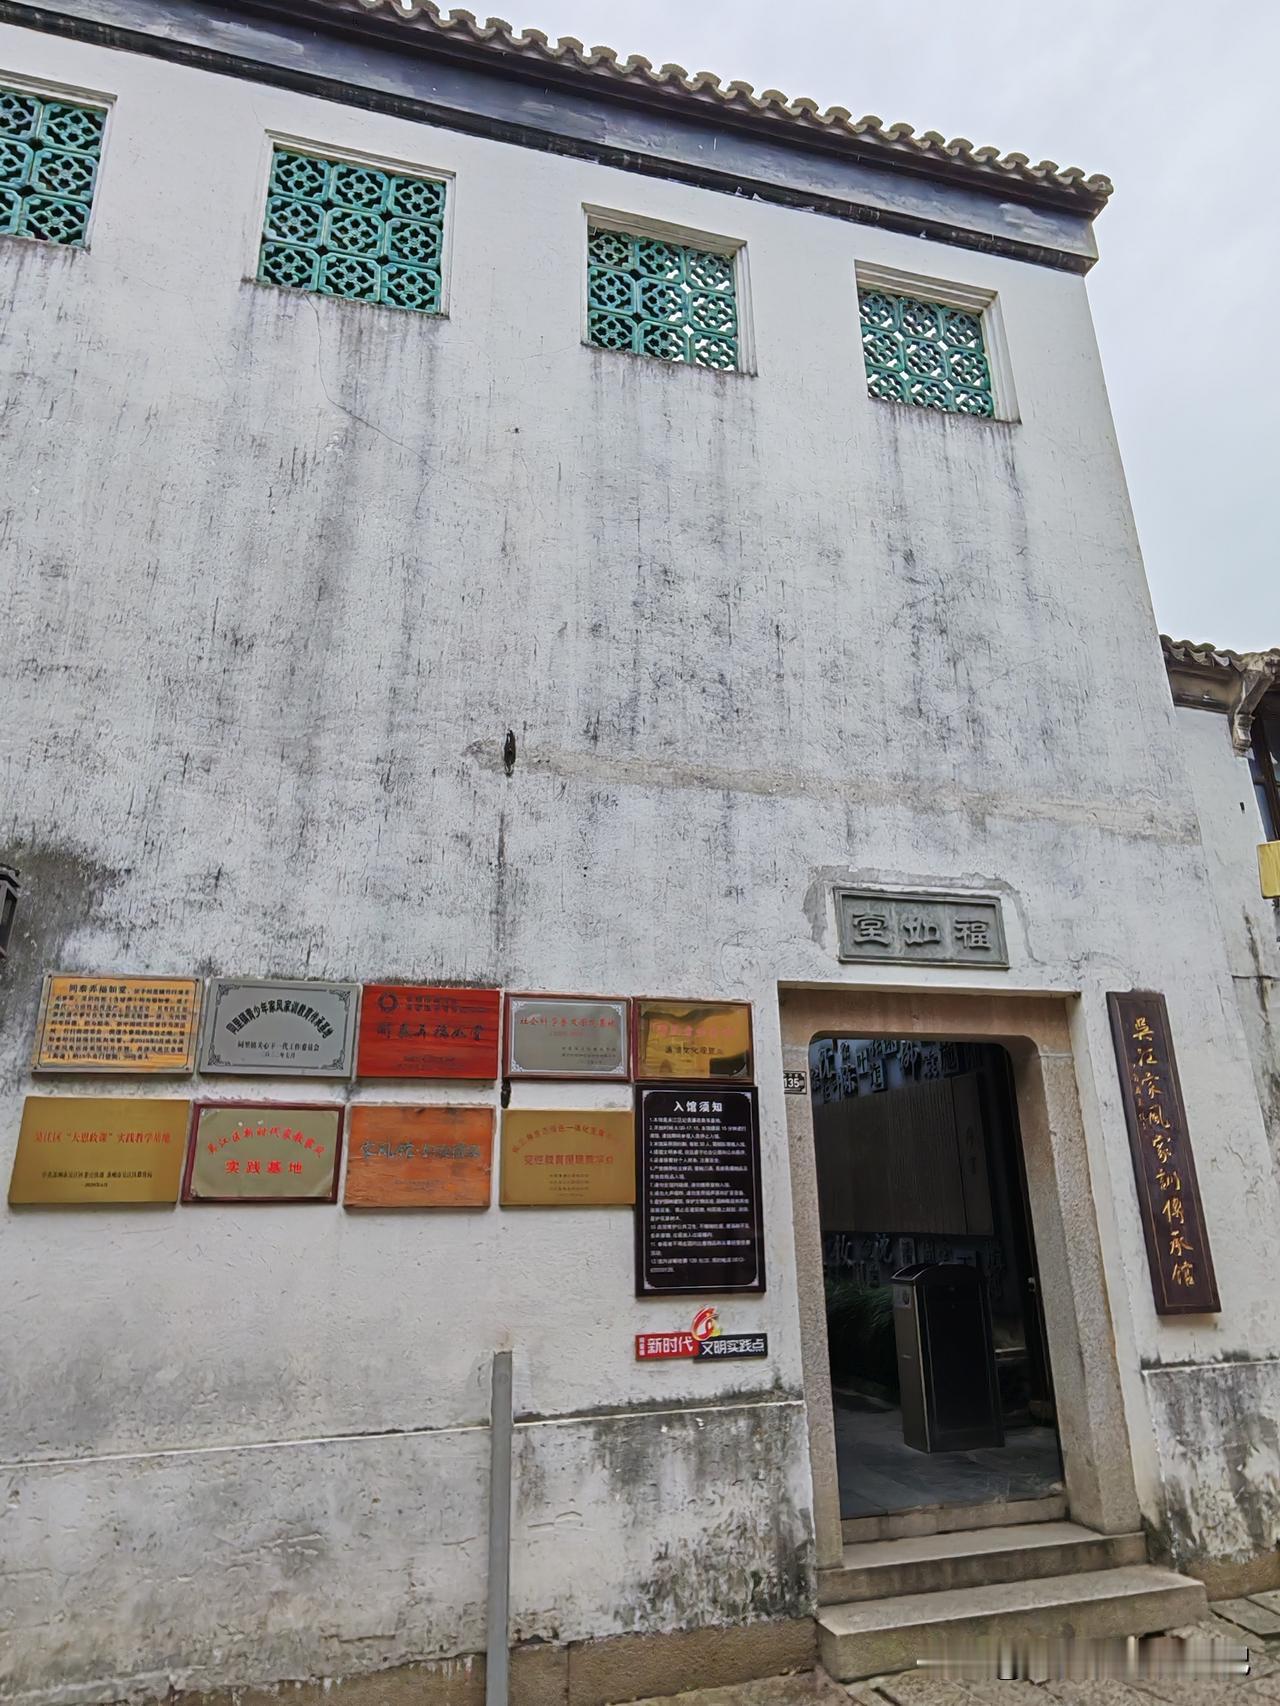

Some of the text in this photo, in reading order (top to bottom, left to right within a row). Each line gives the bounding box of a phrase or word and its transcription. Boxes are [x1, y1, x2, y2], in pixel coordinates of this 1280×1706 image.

[673, 1100, 723, 1112] 入馆须知
[225, 1159, 304, 1175] 实践基地
[647, 1336, 693, 1354] 新时代
[701, 1338, 765, 1355] 文明实践点
